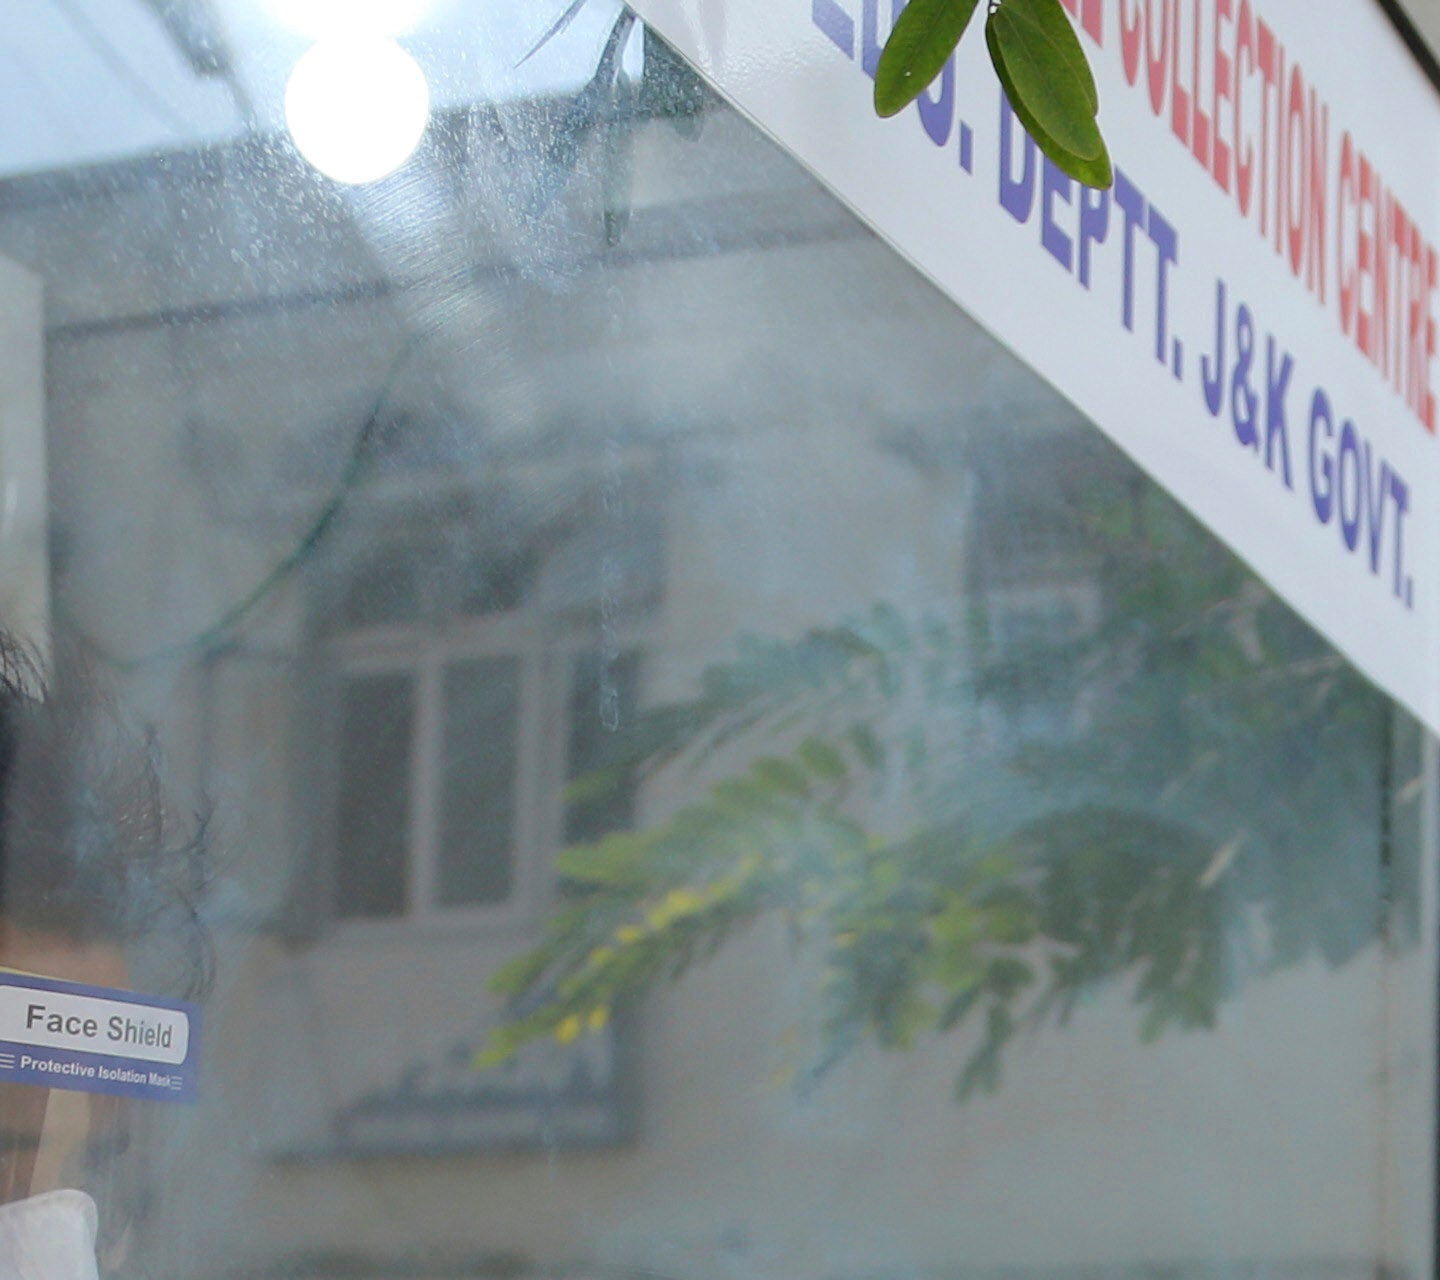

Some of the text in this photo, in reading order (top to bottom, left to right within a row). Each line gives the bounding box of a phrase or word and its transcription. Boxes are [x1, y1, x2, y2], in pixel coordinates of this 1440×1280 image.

[1338, 130, 1437, 437] CENTRE
[1201, 277, 1294, 492] J&K
[1308, 386, 1413, 610] GOVT.
[21, 1055, 171, 1087] Protective Isolation Mask
[26, 1004, 172, 1049] Face Shield
